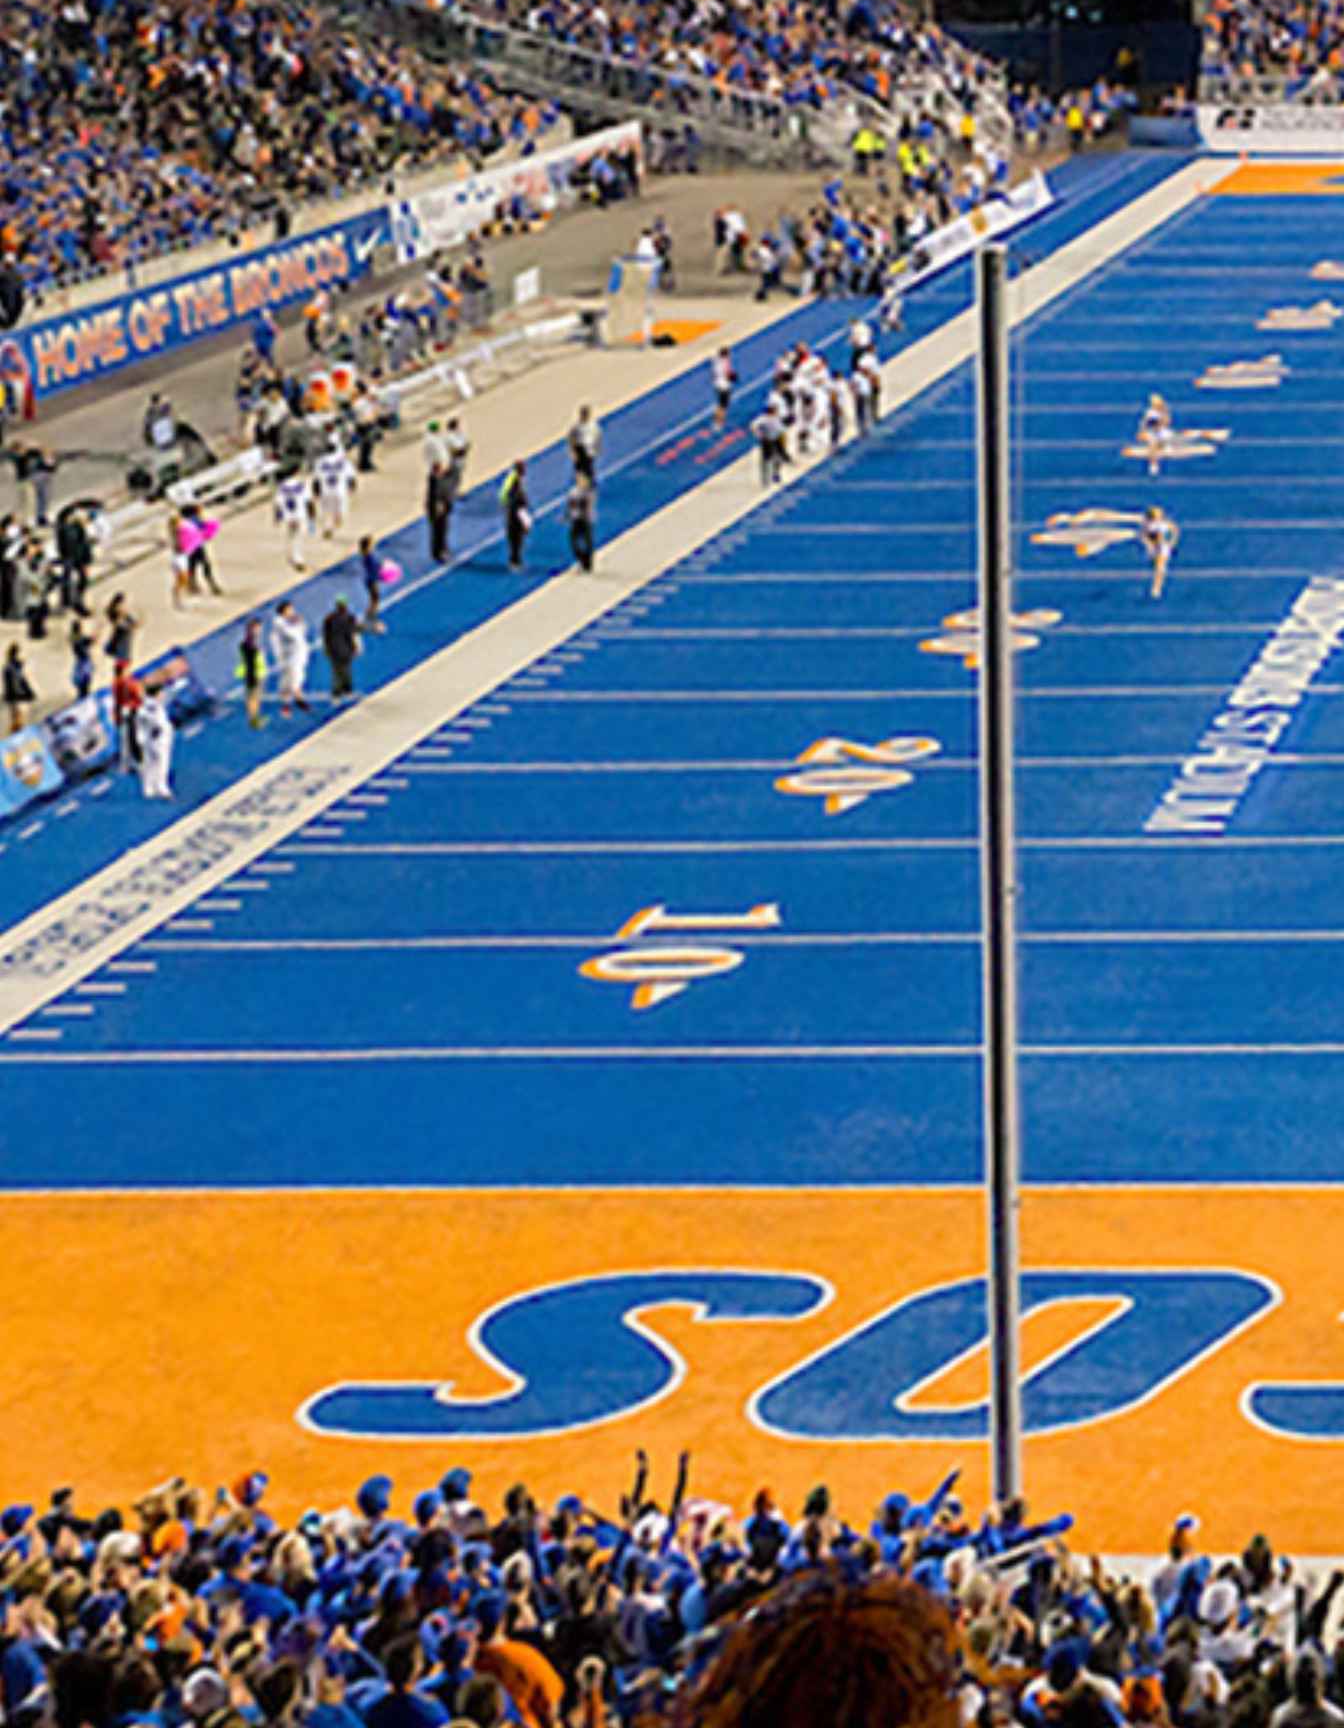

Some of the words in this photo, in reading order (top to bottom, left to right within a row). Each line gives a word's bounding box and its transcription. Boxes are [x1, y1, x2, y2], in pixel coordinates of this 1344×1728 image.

[31, 307, 128, 388] HOME
[129, 290, 172, 352] OF
[173, 273, 229, 335] THE
